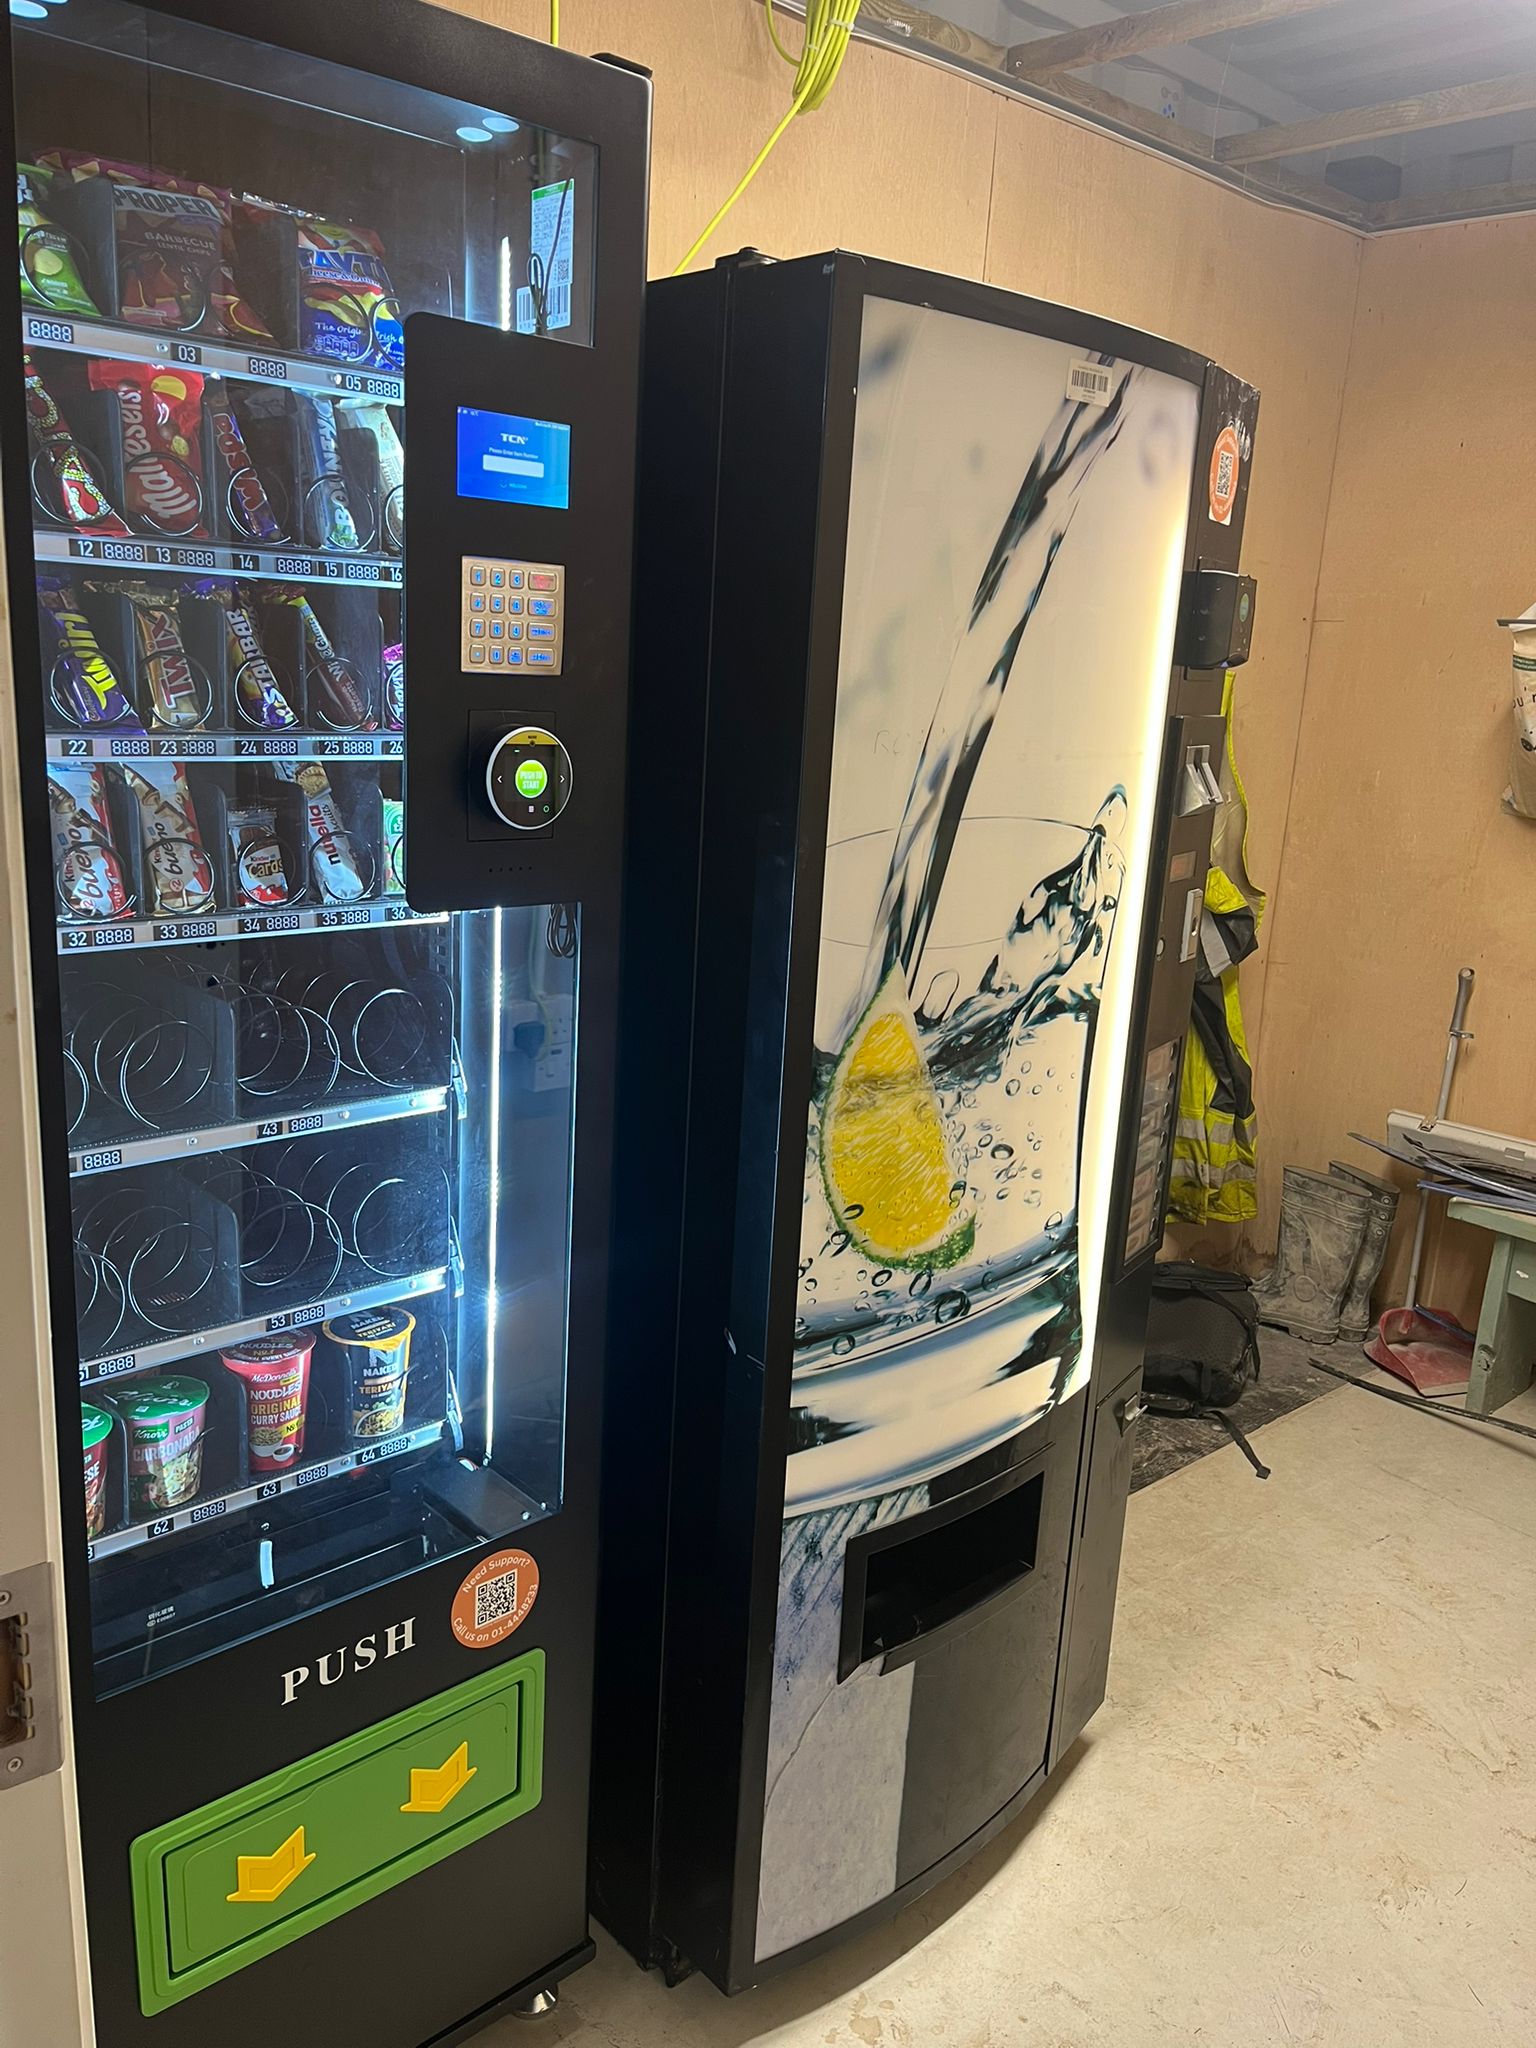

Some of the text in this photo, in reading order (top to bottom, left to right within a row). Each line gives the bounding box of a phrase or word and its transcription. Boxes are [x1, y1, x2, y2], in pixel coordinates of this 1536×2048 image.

[113, 188, 219, 219] PROPER
[144, 231, 216, 250] BARBECUE
[178, 346, 196, 361] 03
[346, 375, 361, 391] 05
[500, 433, 526, 445] TCN
[78, 540, 94, 557] 12
[156, 547, 171, 563] 13
[239, 554, 253, 569] 14
[325, 562, 337, 576] 15
[390, 567, 402, 581] 16
[54, 611, 117, 710] Twirl
[139, 611, 195, 709] Twix
[226, 608, 285, 705] STARBAR
[321, 648, 345, 682] Wie
[69, 741, 87, 755] 22
[160, 742, 177, 755] 23
[241, 741, 256, 754] 24
[325, 741, 339, 754] 25
[390, 741, 403, 754] 26
[322, 804, 345, 838] bscuits
[308, 805, 341, 866] nutella
[154, 822, 183, 875] bueno
[68, 828, 103, 898] bueno
[248, 860, 283, 878] Cards
[322, 913, 337, 925] 35
[392, 907, 405, 919] 36
[160, 926, 177, 938] 33
[244, 919, 260, 931] 34
[68, 933, 87, 947] 32
[262, 1122, 278, 1135] 43
[271, 1315, 286, 1327] 53
[250, 1381, 301, 1400] NOODLES
[251, 1394, 301, 1415] ORIGINAL
[175, 1417, 193, 1434] PASTA
[250, 1413, 279, 1425] CURRY
[134, 1428, 168, 1439] Knorr
[361, 1450, 375, 1462] 64
[262, 1484, 277, 1496] 63
[153, 1520, 169, 1534] 62
[462, 1556, 531, 1593] Need Support?
[453, 1617, 468, 1637] Call
[465, 1631, 476, 1641] us
[476, 1633, 489, 1642] on
[280, 1616, 416, 1706] PUSH
